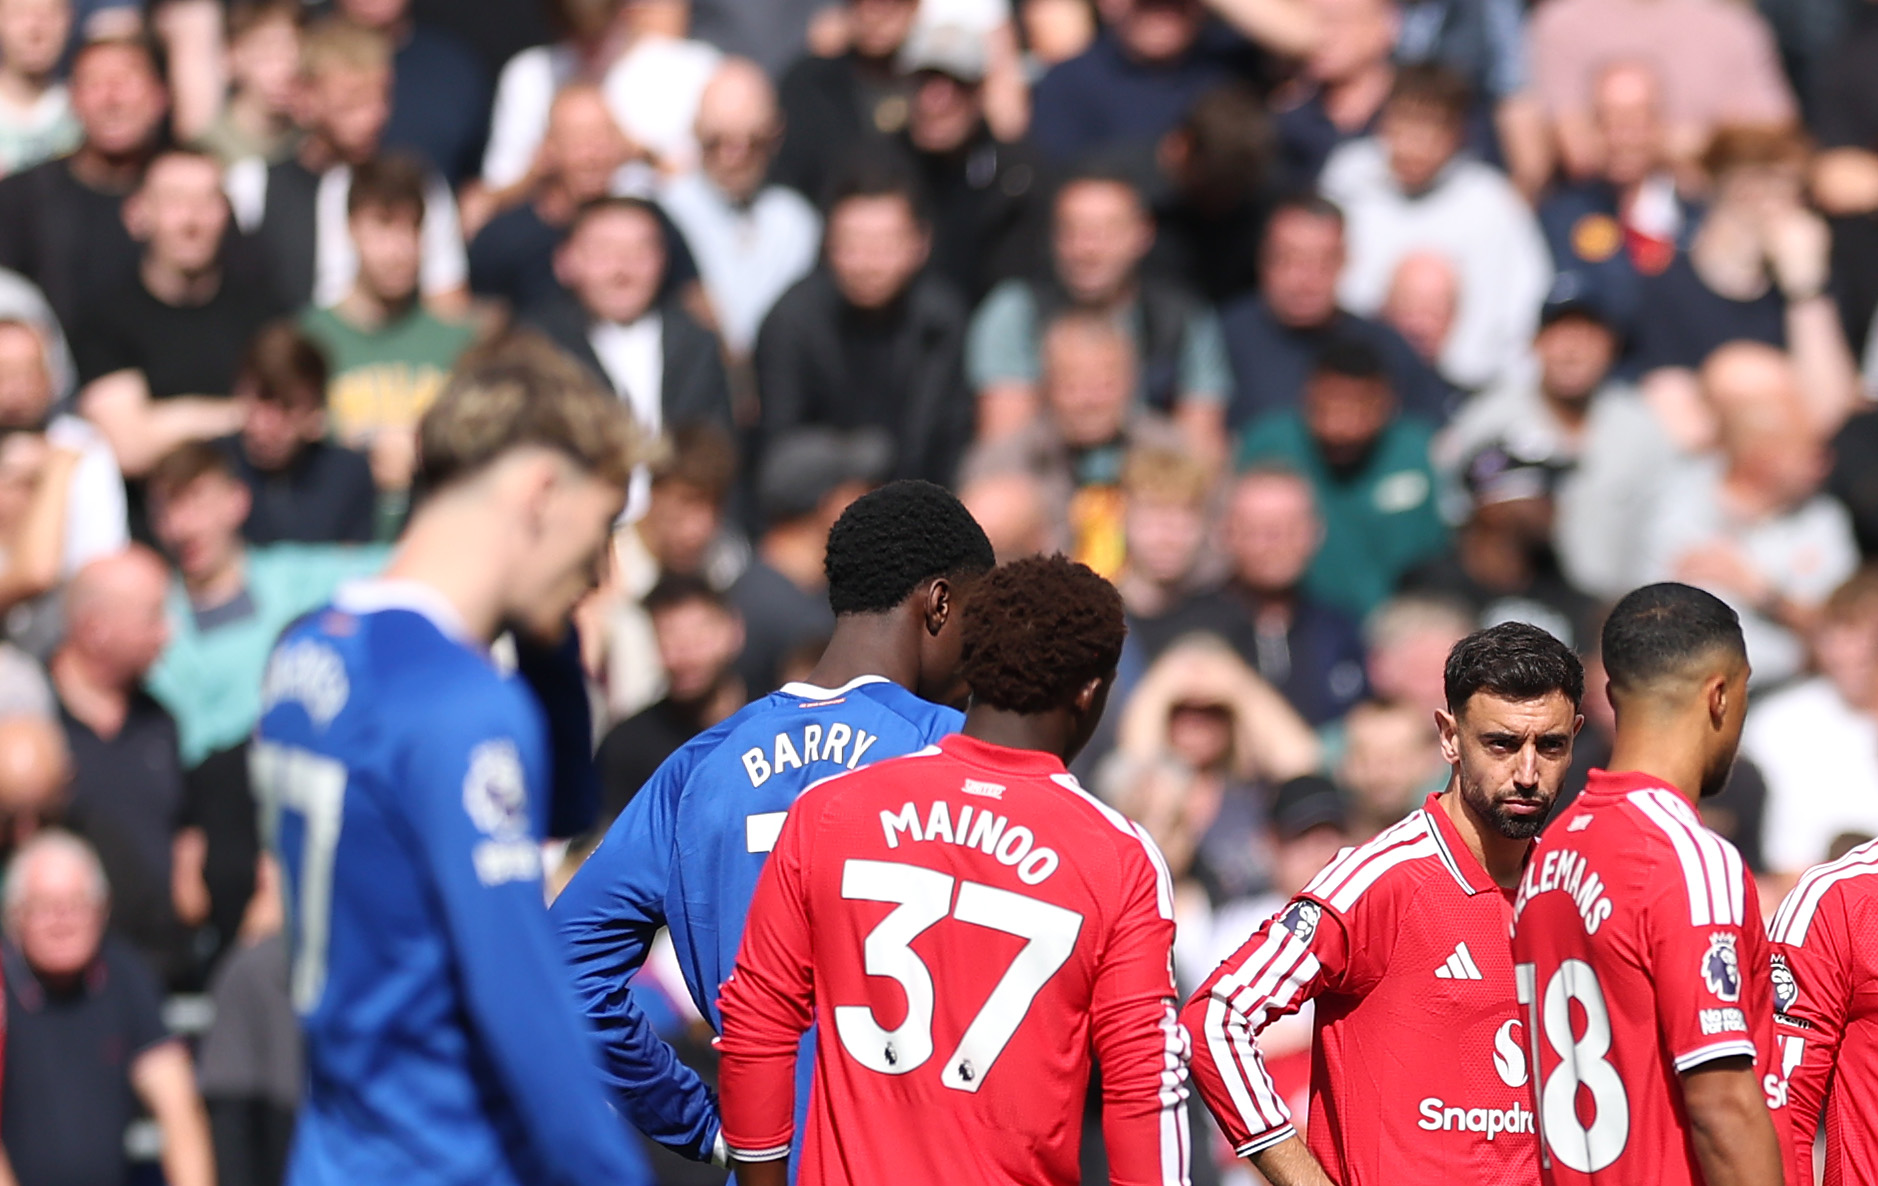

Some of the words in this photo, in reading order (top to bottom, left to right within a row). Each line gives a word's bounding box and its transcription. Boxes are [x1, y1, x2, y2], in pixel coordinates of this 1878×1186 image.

[741, 722, 878, 788] BARRY
[879, 800, 1060, 885] MAINOO
[834, 859, 1084, 1093] 37
